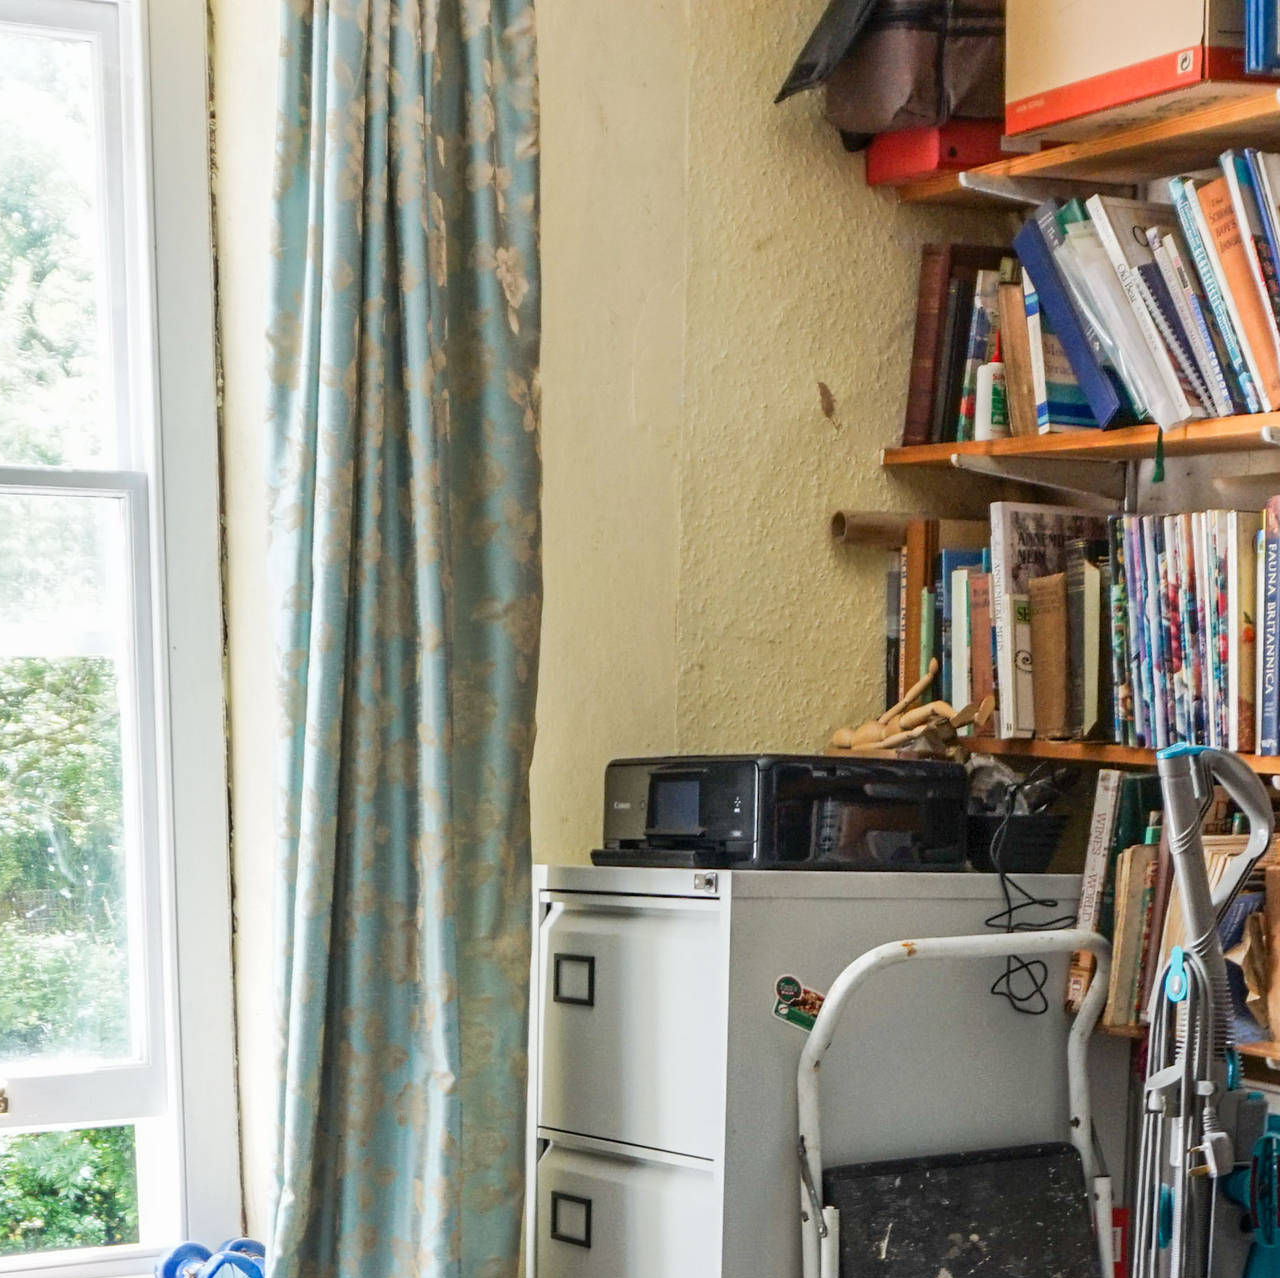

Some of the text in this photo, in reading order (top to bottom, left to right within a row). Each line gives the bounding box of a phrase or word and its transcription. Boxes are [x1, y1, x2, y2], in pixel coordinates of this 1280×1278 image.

[1262, 543, 1277, 693] FAUNA BRITANNICA
[1081, 811, 1106, 922] WINES WORLD
